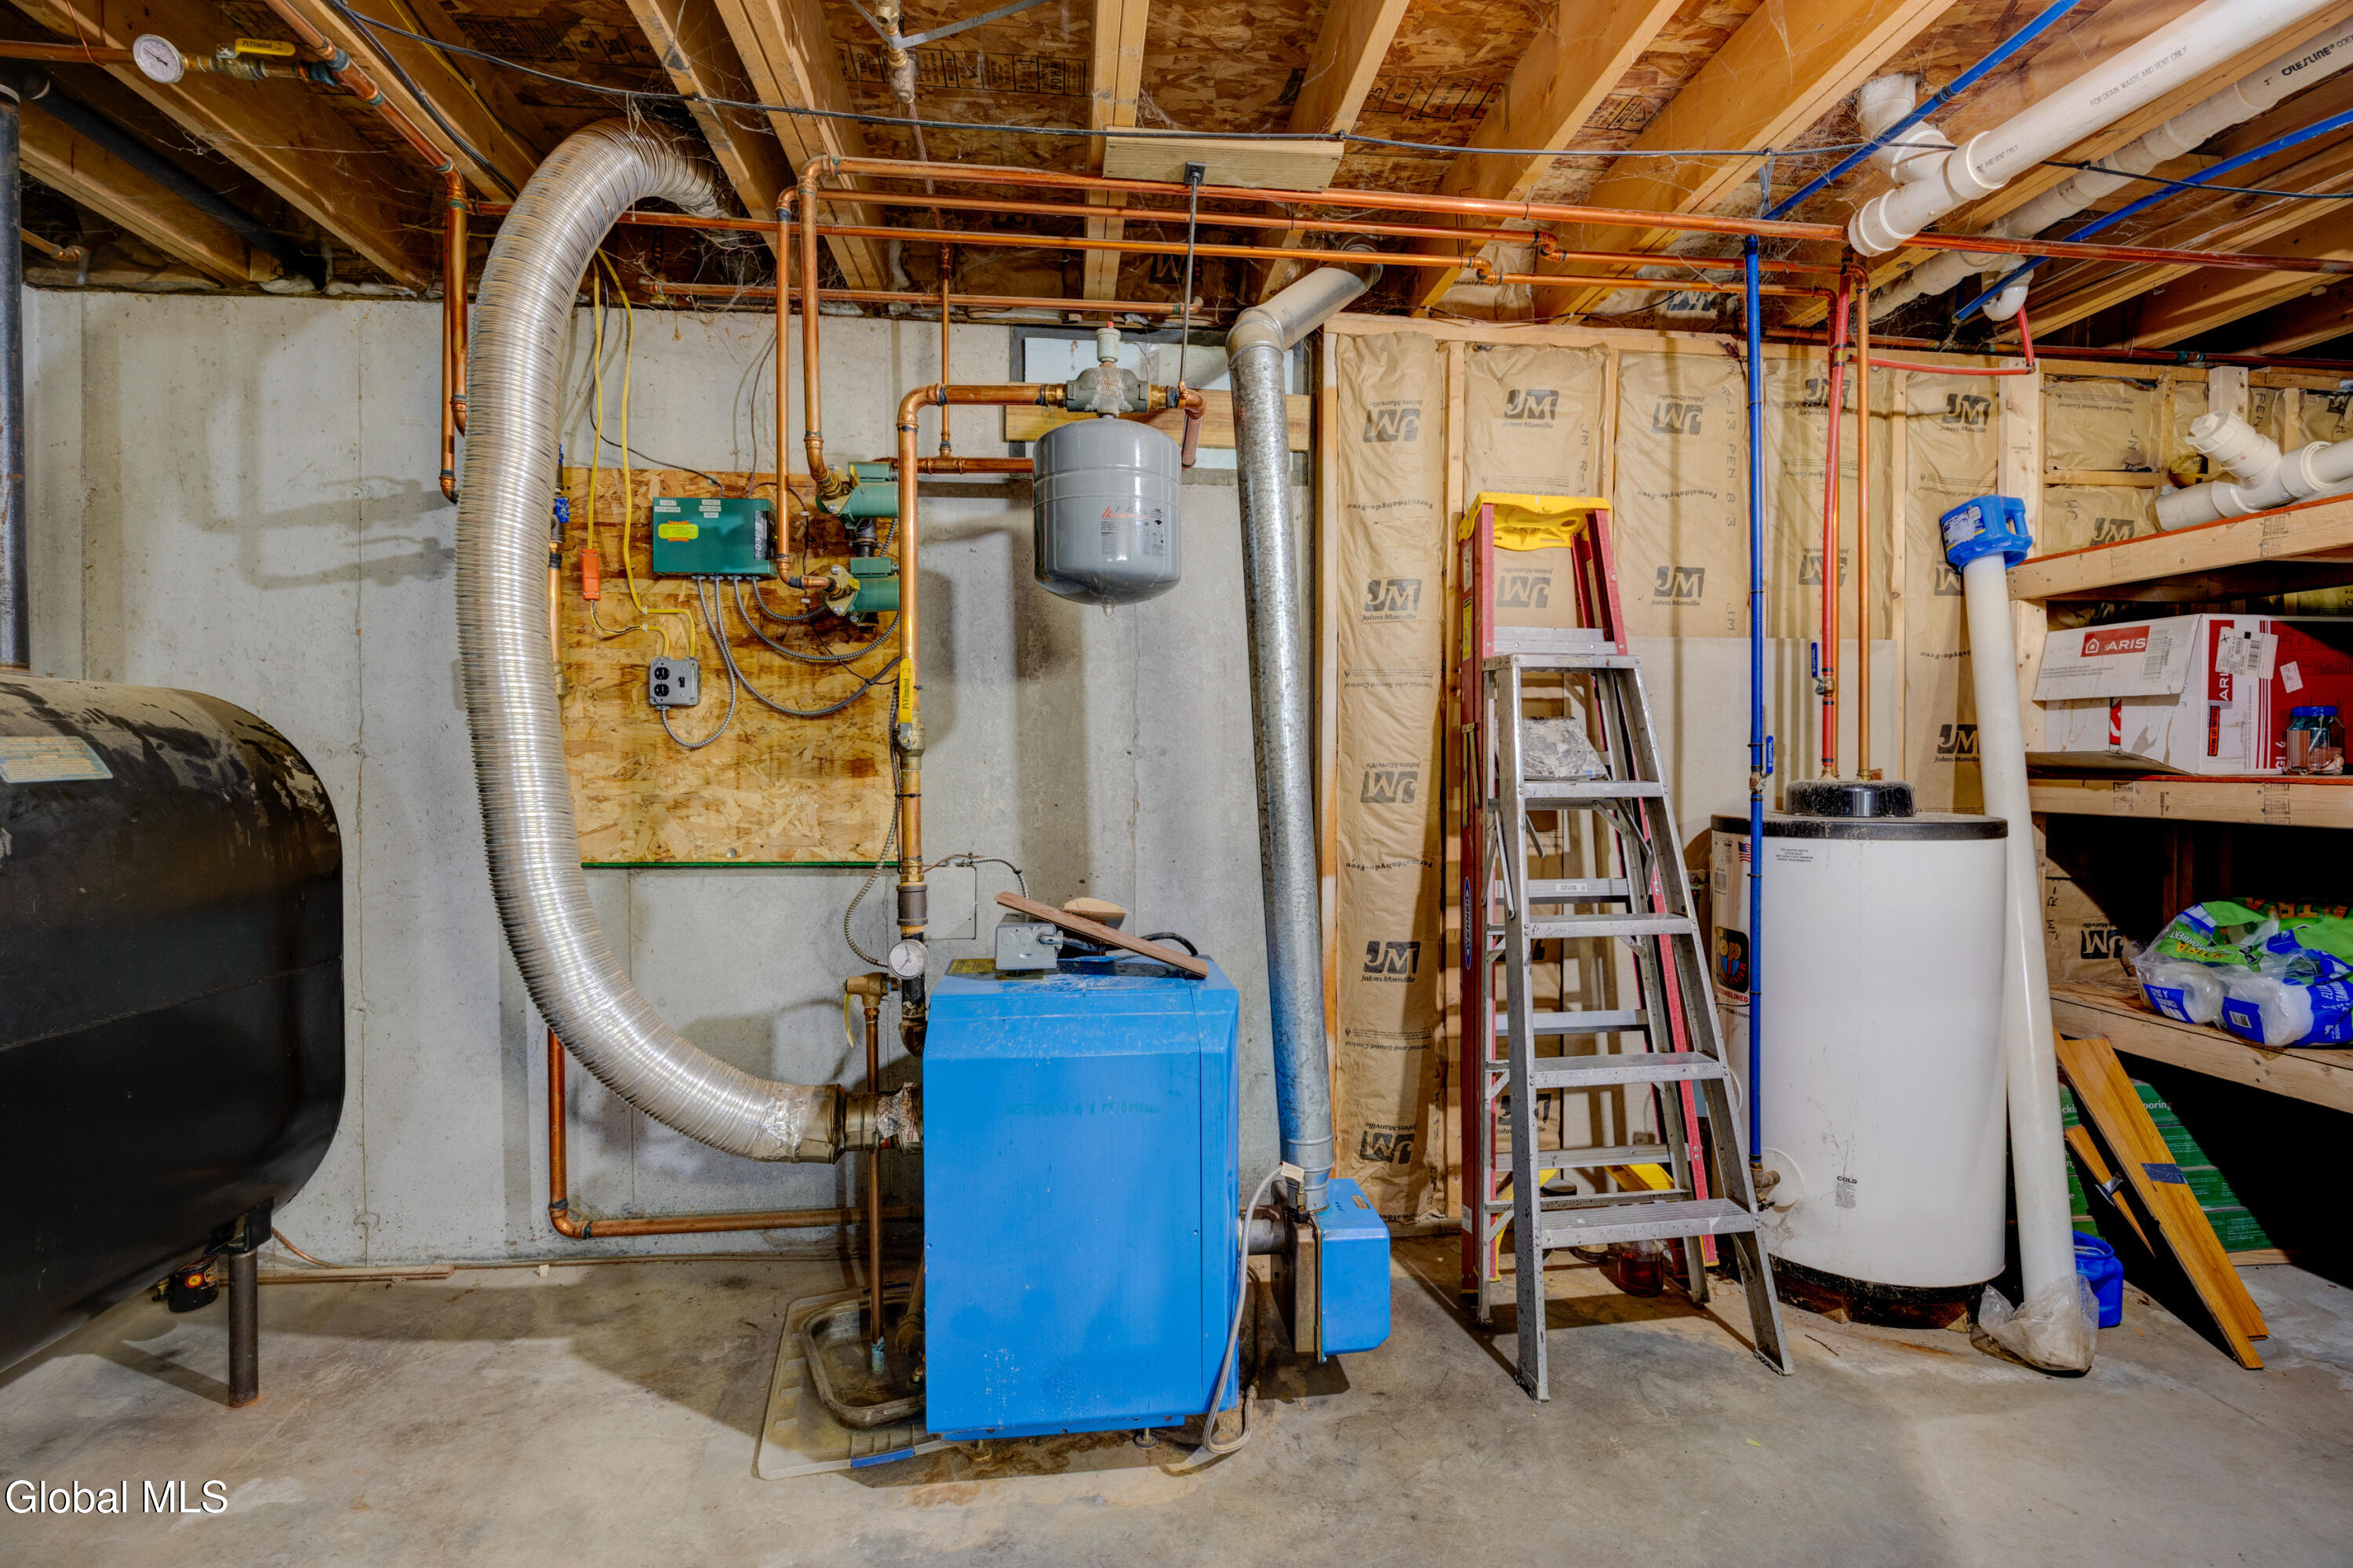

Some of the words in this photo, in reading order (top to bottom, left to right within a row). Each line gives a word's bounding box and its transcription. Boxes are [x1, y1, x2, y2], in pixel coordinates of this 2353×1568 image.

[2170, 45, 2188, 62] ONLY
[1504, 388, 1559, 420] JM
[1651, 402, 1703, 435] JM
[1364, 579, 1422, 612] JM
[1496, 575, 1551, 609] JM
[1653, 566, 1705, 598] JM
[2108, 638, 2147, 651] ARIS
[2219, 672, 2230, 702] ARI
[1360, 770, 1418, 804] JM
[1364, 940, 1420, 975] JM
[1837, 1176, 1857, 1184] COLD
